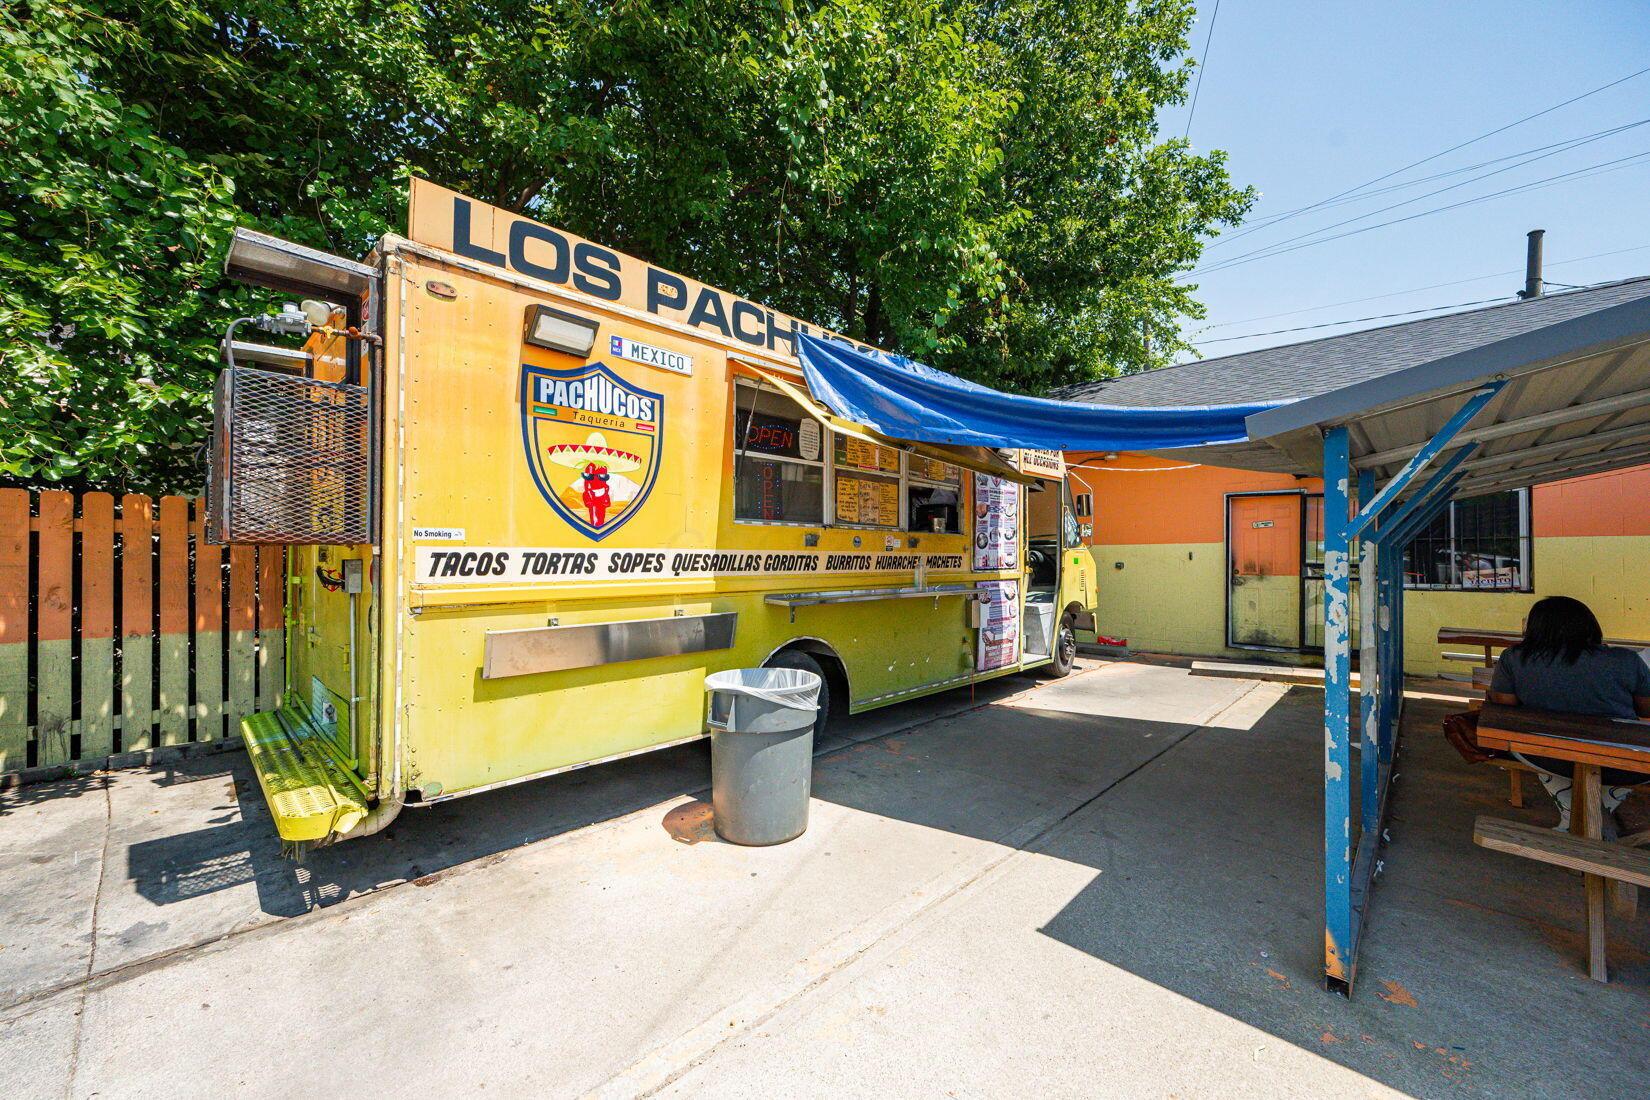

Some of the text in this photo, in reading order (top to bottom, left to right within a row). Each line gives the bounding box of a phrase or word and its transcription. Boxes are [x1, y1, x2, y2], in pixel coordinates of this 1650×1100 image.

[454, 197, 621, 301] LOS
[631, 343, 684, 370] MEXICO
[539, 375, 652, 421] PACHUCOS
[573, 411, 625, 428] Taqueria
[748, 426, 792, 448] OPEN
[763, 467, 775, 520] OPEN
[424, 529, 452, 539] Smoking
[428, 551, 509, 577] TACOS
[520, 552, 598, 575] TORTAS
[608, 552, 666, 573] SOPES
[671, 553, 761, 576] QUESADILLAS
[763, 554, 819, 572] GORDITAS
[826, 555, 870, 571] BURRITOS
[926, 555, 963, 569] MACHETES
